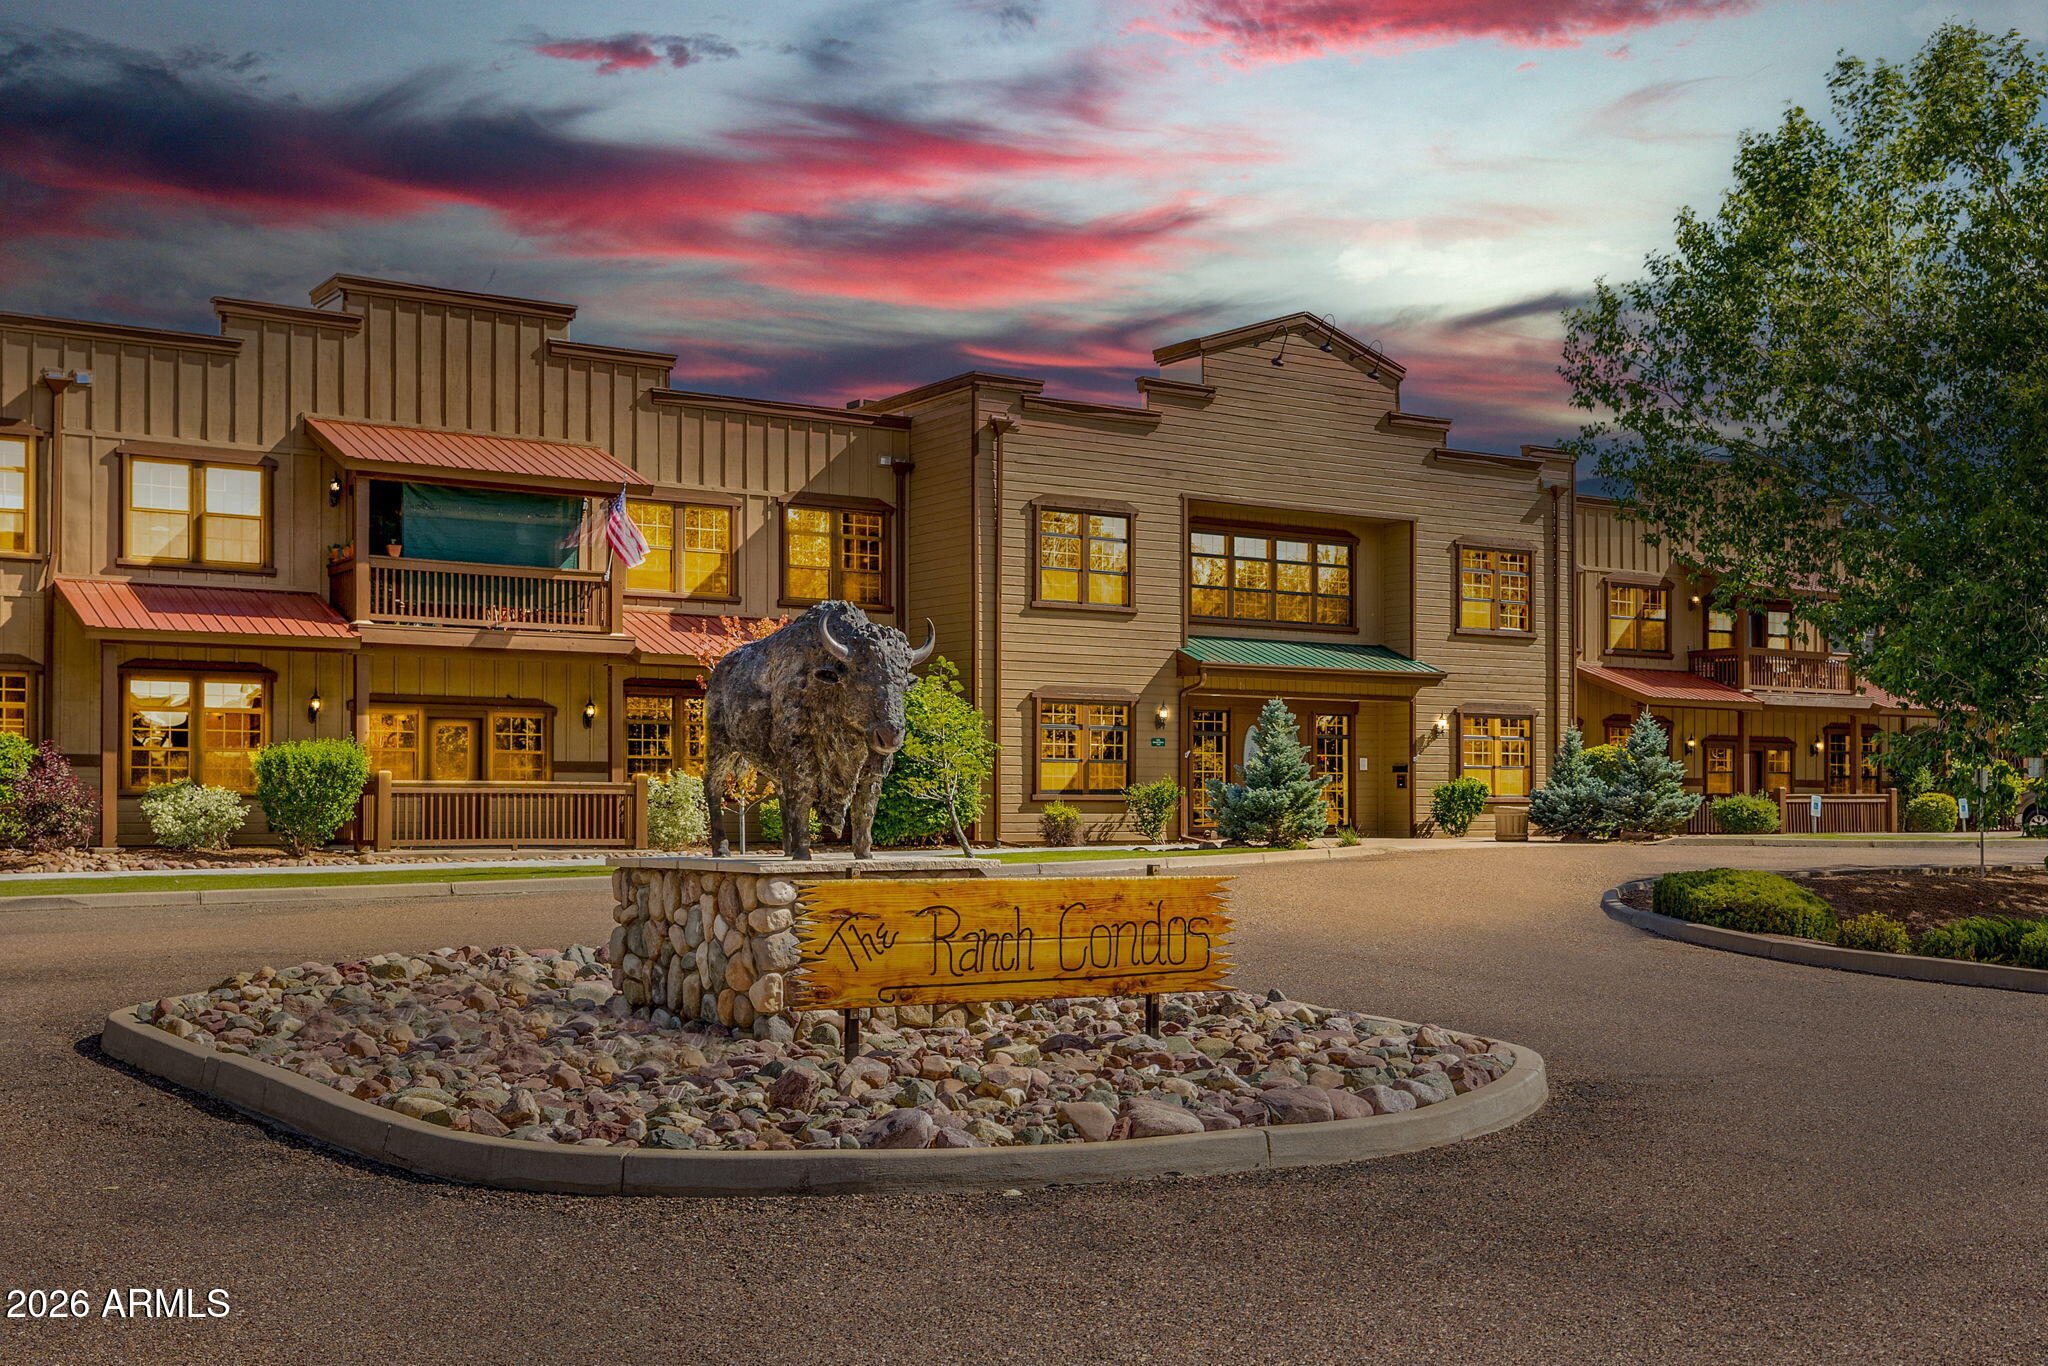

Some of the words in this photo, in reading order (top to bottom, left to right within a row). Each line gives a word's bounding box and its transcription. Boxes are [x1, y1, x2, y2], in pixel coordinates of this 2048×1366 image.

[815, 914, 900, 972] The
[914, 904, 1035, 978] Ranch
[1058, 899, 1211, 973] Condos
